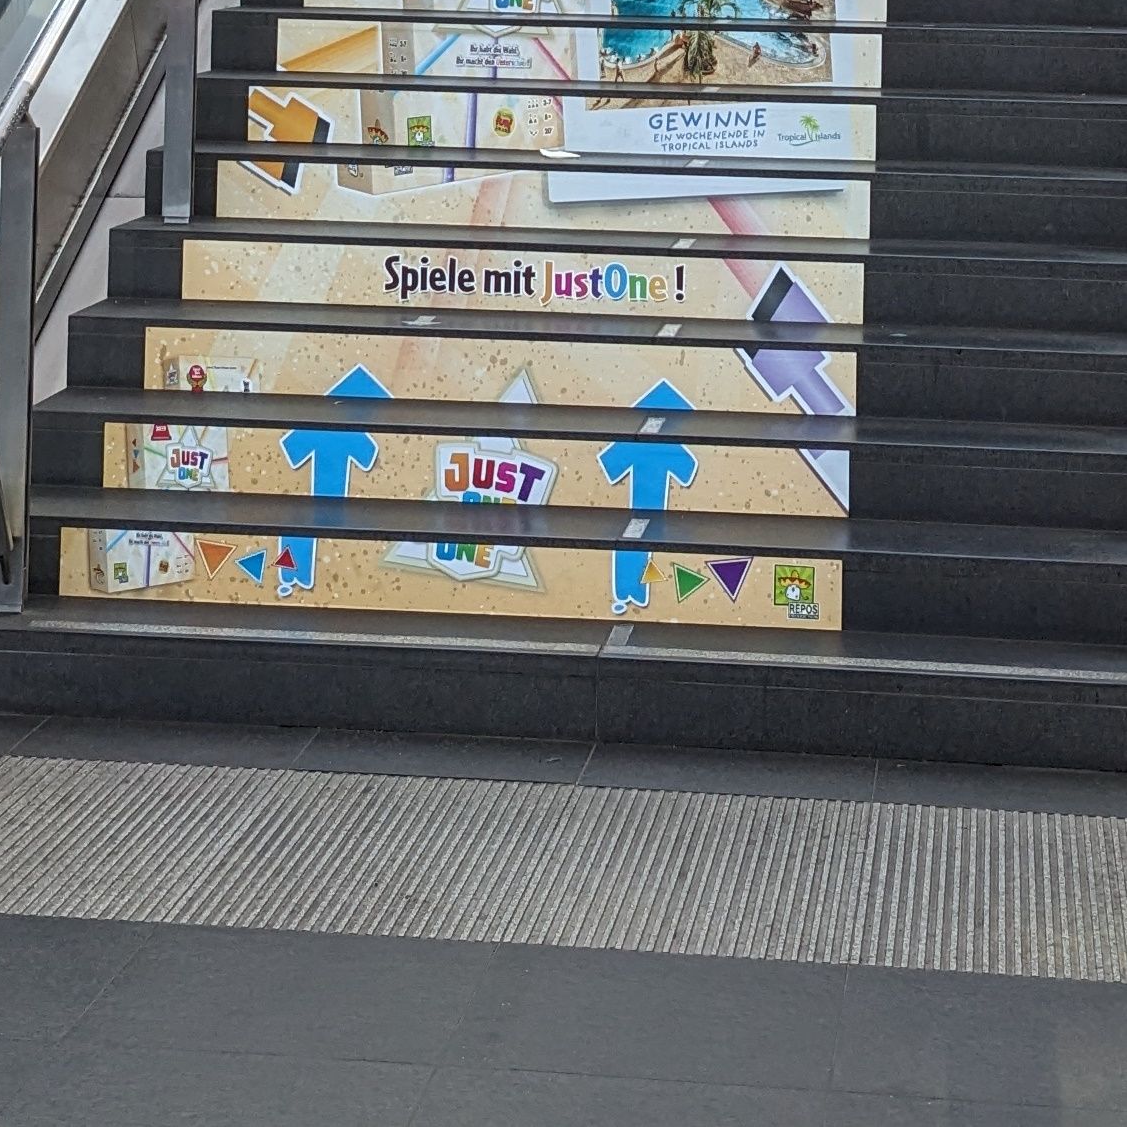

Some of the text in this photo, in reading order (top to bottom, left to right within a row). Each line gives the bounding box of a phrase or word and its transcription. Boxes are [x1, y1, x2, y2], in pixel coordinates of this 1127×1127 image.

[648, 107, 767, 132] GEWINNE
[654, 129, 765, 142] EIN WOCHENENDE IN
[777, 132, 841, 143] Tropical Islands
[661, 139, 758, 152] TROPICAL ISLANDS
[383, 254, 475, 302] Spiele
[483, 259, 536, 298] mit
[539, 259, 668, 307] JustOne
[170, 448, 209, 470] JUST
[177, 466, 200, 482] ONE
[444, 452, 546, 502] JUST
[789, 603, 818, 615] REPOS
